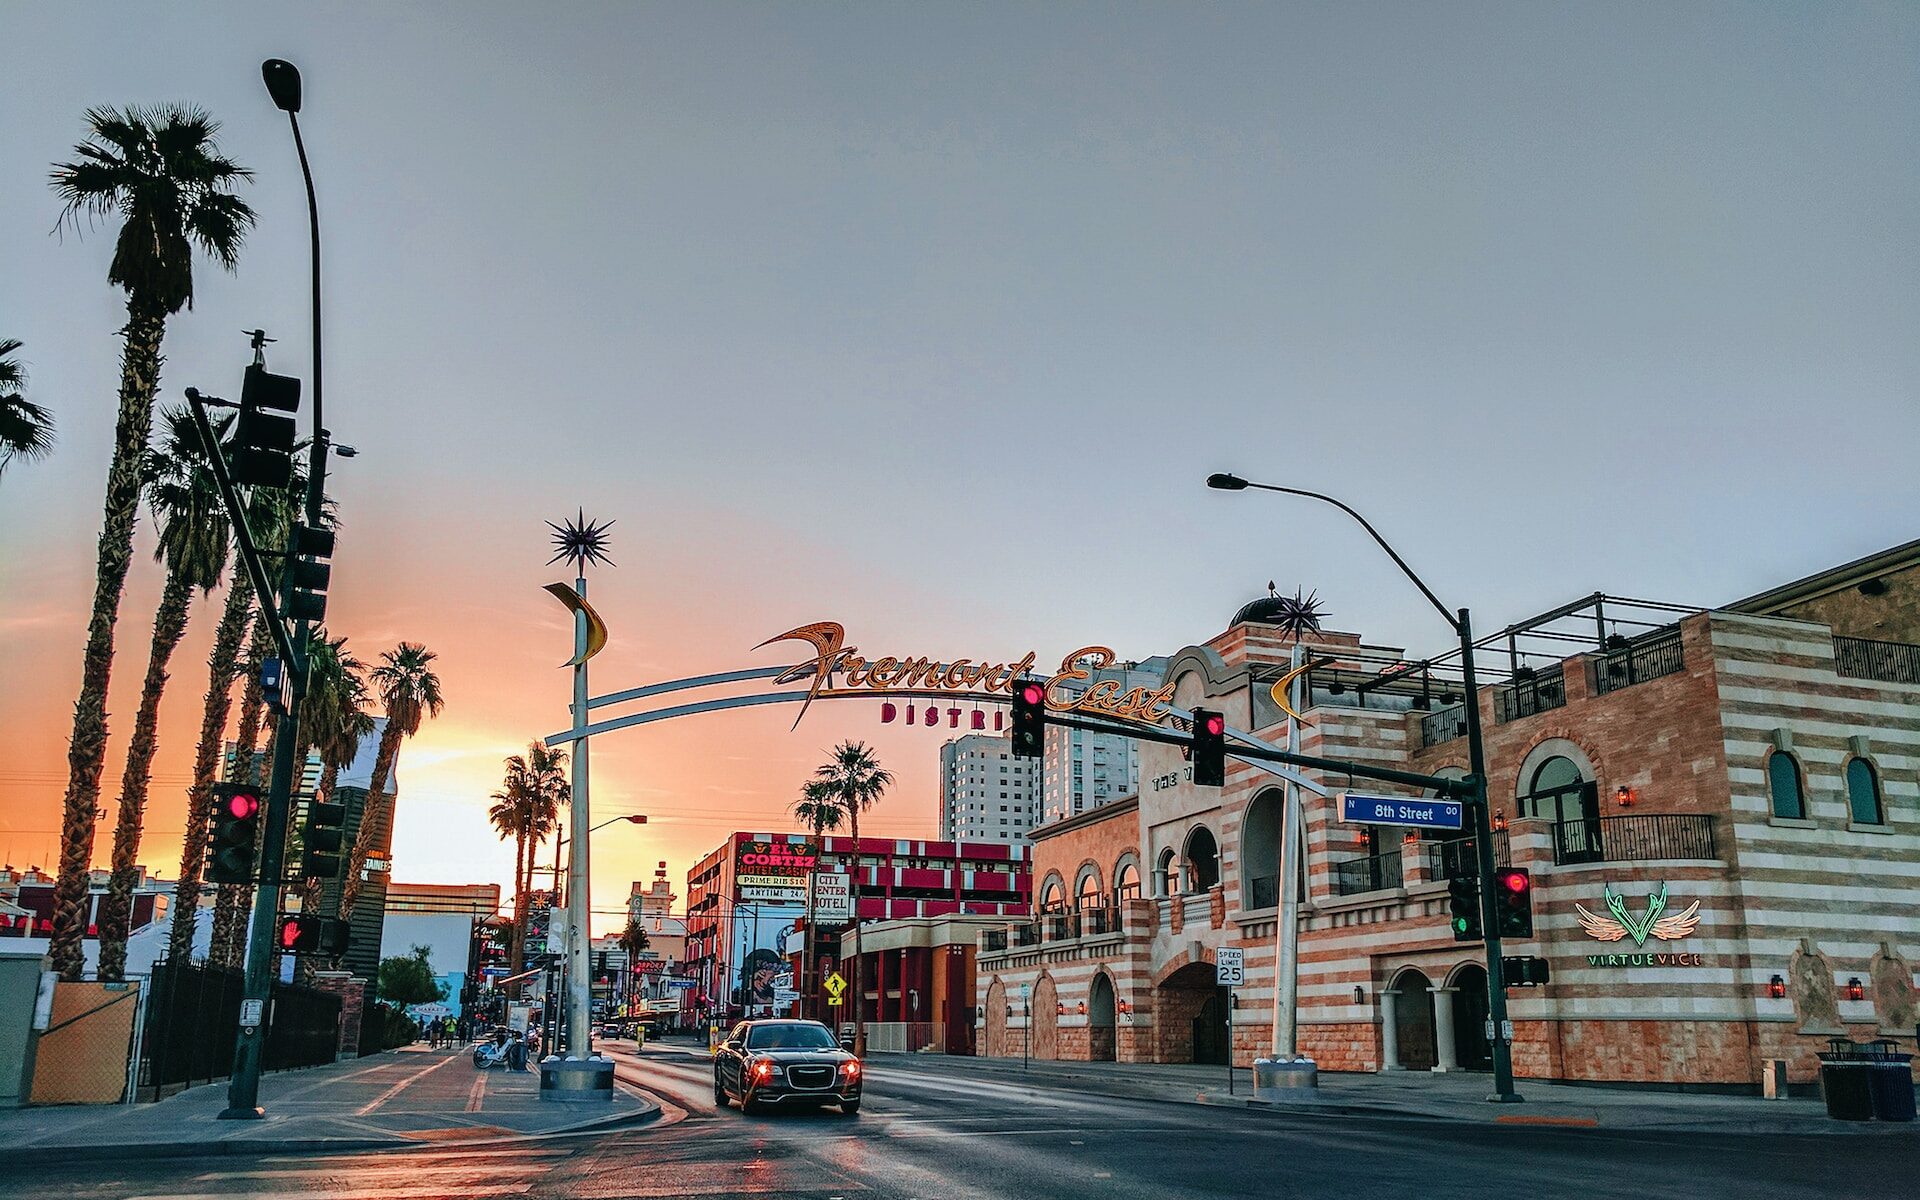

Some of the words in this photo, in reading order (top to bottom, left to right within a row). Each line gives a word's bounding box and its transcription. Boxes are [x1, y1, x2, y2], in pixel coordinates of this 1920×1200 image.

[750, 621, 1036, 732] Fremont
[1044, 646, 1177, 720] East
[881, 703, 1012, 732] DISTRI
[1152, 772, 1177, 791] THE
[1348, 800, 1355, 808] N
[1375, 804, 1395, 818] 8th
[1399, 805, 1433, 820] Street
[770, 844, 792, 855] EL
[742, 853, 815, 868] CORTEZ
[740, 865, 773, 875] HOTEL
[820, 876, 839, 885] CITY
[750, 889, 783, 897] ANYTIME
[816, 886, 847, 896] ENTER
[1219, 967, 1241, 981] 25
